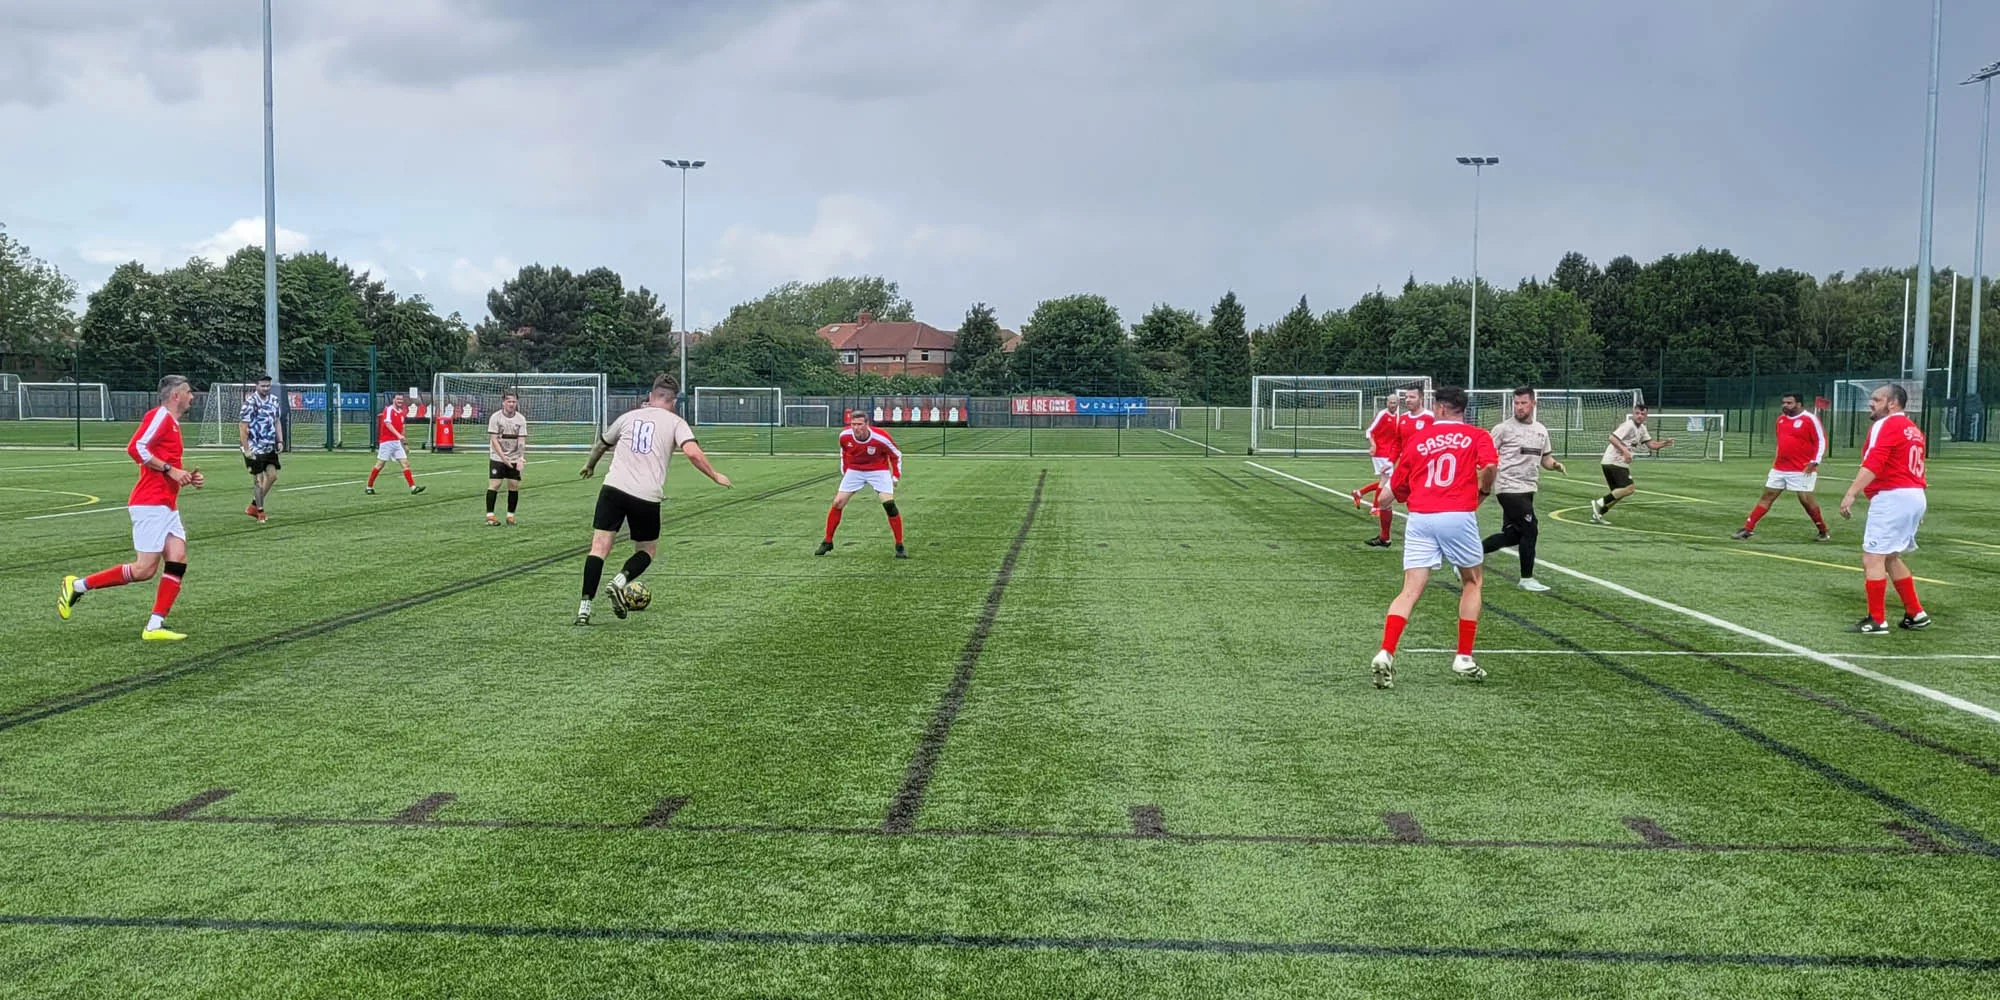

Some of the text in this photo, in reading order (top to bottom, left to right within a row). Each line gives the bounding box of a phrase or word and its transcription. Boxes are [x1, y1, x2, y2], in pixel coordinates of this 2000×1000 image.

[1016, 399, 1029, 412] WE
[1031, 399, 1047, 412] ARE
[631, 419, 656, 454] 18
[1416, 432, 1472, 456] SASSCO
[1424, 453, 1457, 488] 10
